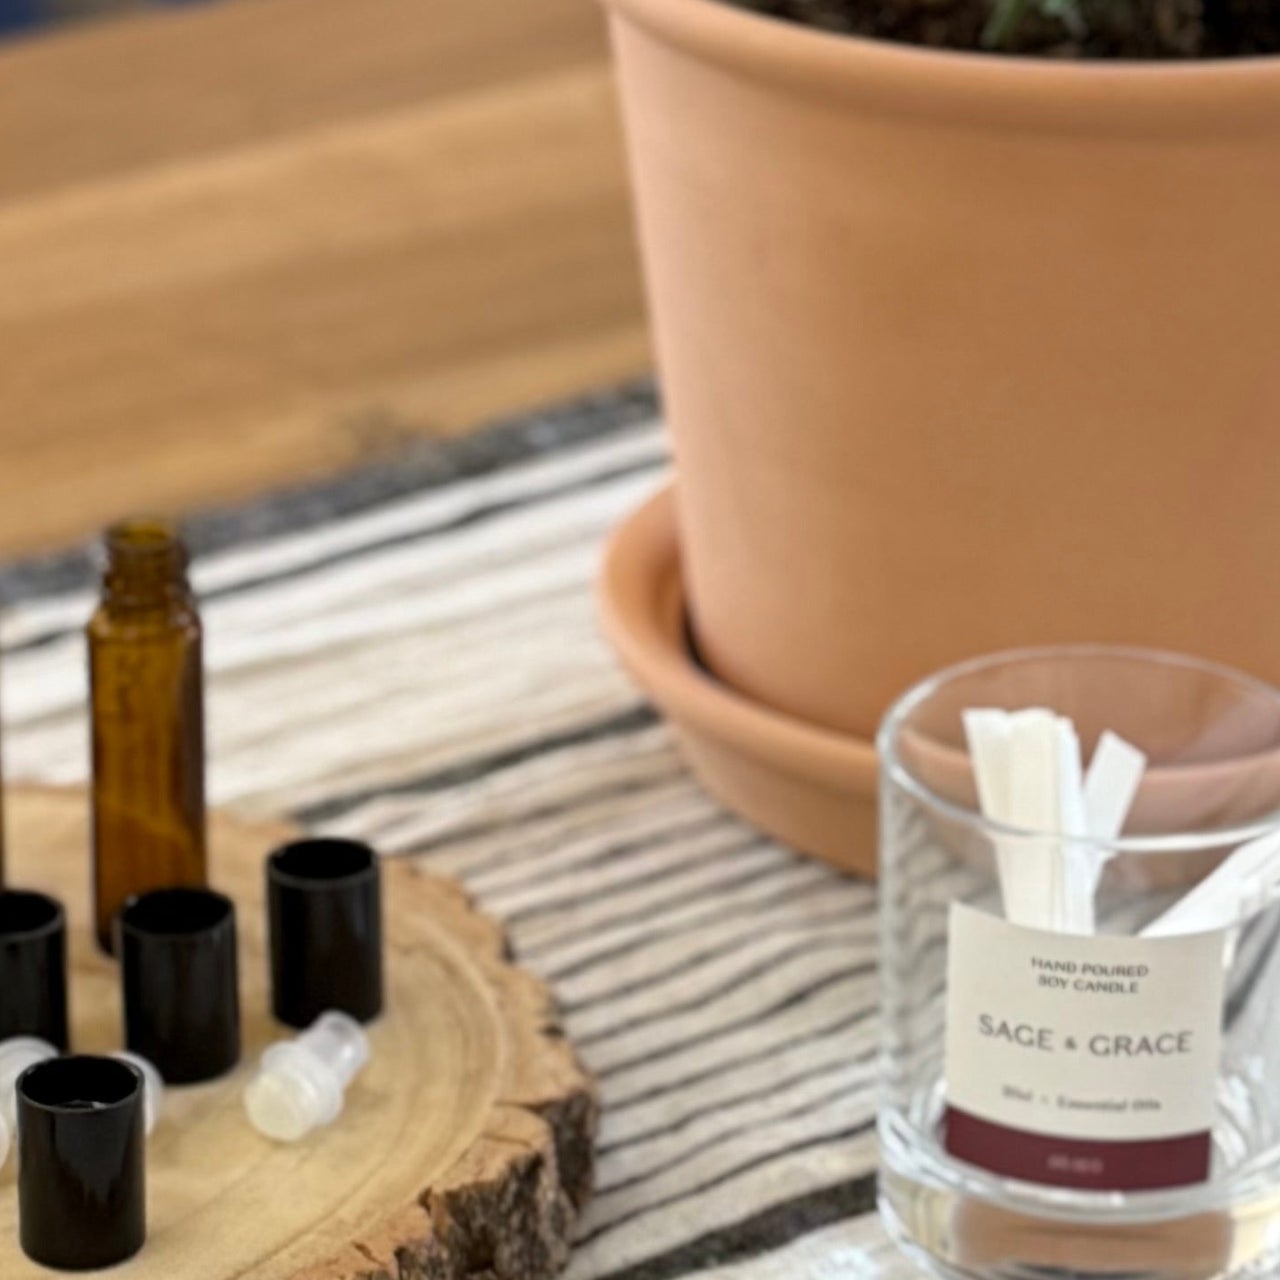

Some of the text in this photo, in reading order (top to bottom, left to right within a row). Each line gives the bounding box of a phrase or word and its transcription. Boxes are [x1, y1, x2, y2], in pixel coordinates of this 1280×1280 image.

[1031, 956, 1149, 978] HAND POURED
[1038, 975, 1140, 995] SOY CANDLE
[977, 1013, 1054, 1051] SAGE
[1089, 1030, 1194, 1058] GRACE
